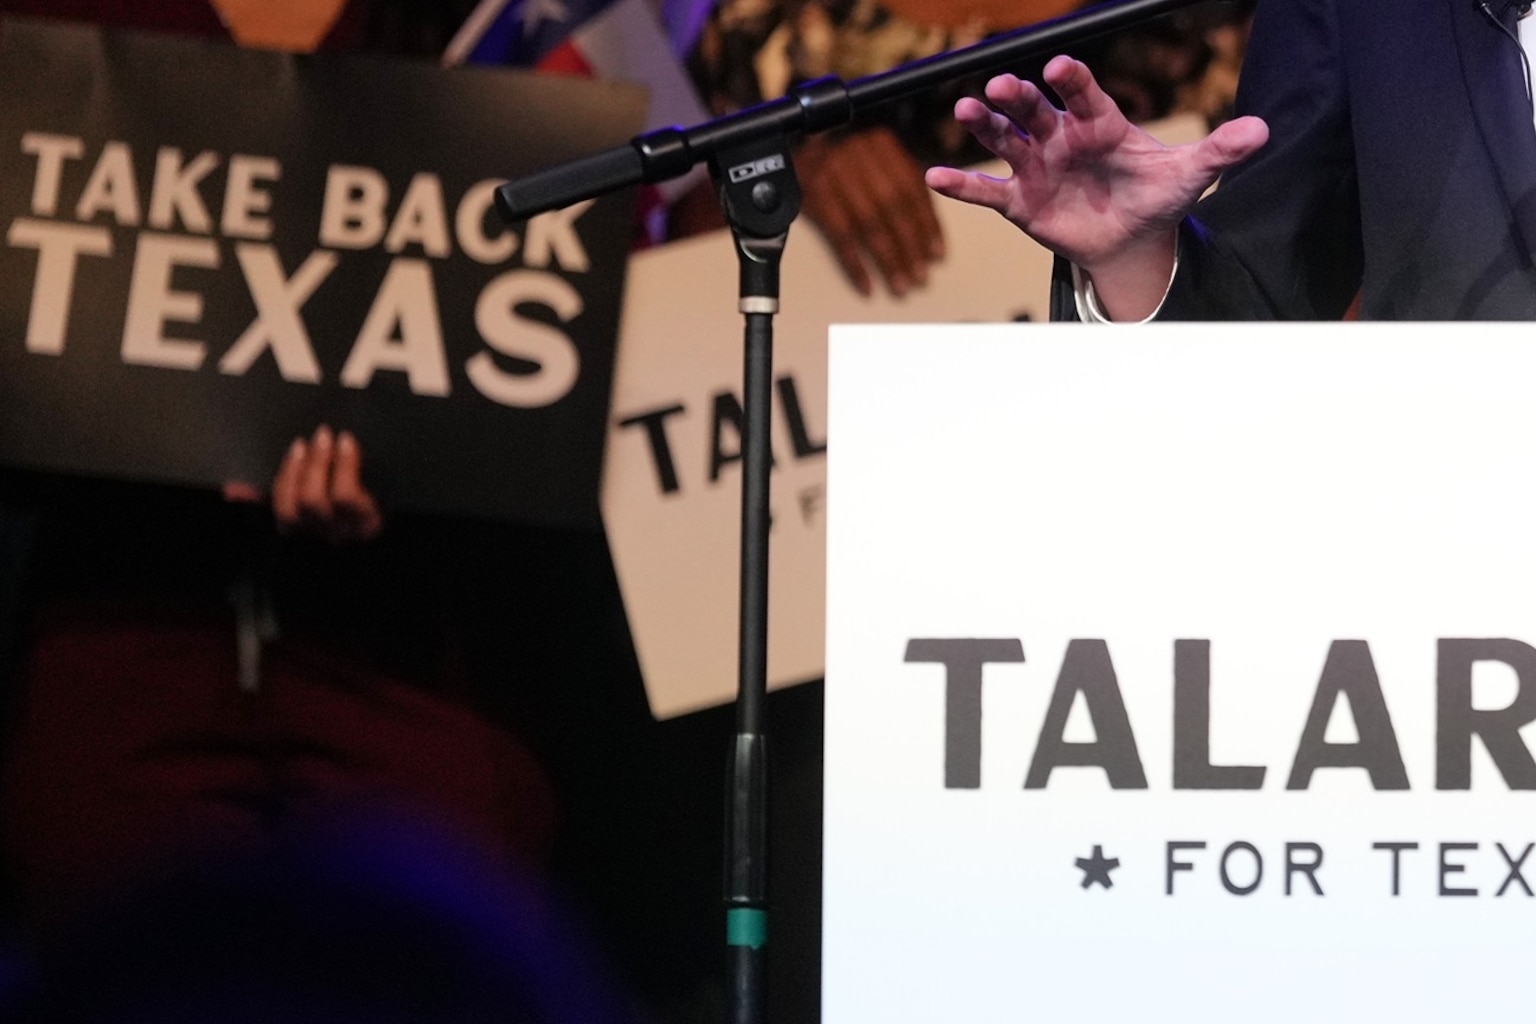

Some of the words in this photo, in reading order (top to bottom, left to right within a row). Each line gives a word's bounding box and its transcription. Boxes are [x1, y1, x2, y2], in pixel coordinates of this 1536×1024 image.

[20, 130, 282, 241] TAKE
[318, 163, 597, 273] BACK
[6, 215, 586, 409] TEXAS
[1164, 840, 1327, 897] FOR
